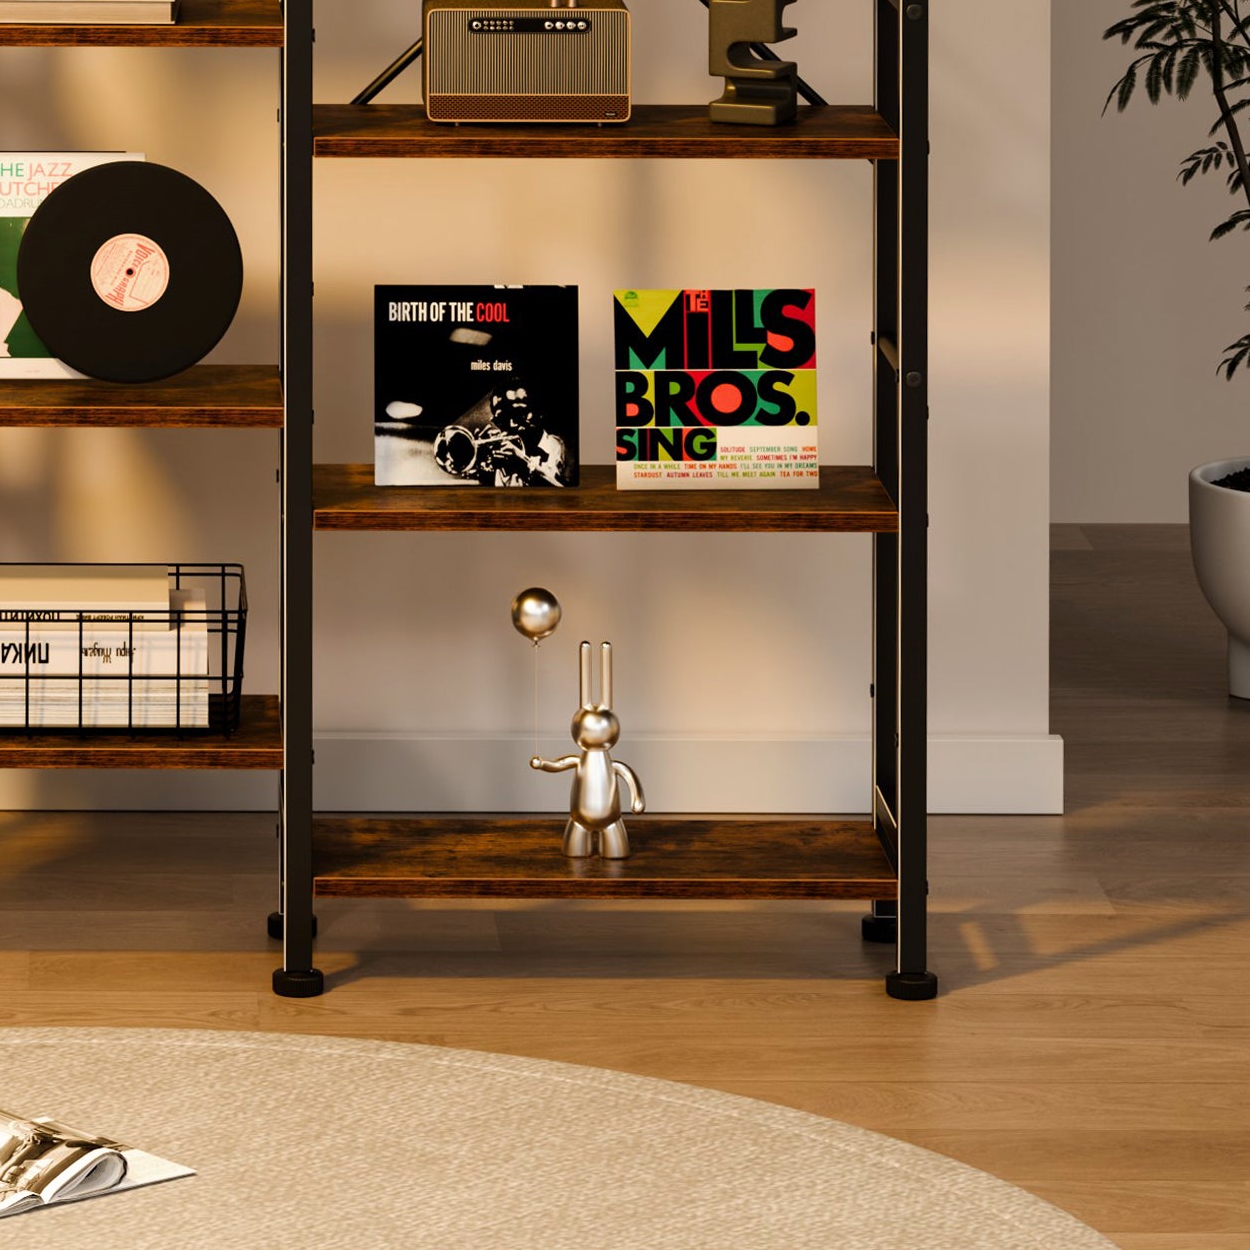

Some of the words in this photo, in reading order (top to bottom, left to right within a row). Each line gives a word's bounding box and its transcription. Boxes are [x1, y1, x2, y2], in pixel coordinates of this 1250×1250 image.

[28, 162, 72, 180] JAZZ
[388, 302, 428, 322] BIRTH
[430, 302, 447, 322] OF
[448, 302, 474, 322] THE
[476, 302, 510, 322] COOL
[613, 289, 816, 370] MILLS
[470, 360, 491, 370] miles
[493, 360, 513, 371] davis
[615, 370, 811, 427] BROS.
[616, 427, 718, 462] SING
[720, 446, 746, 454] SOLITUDE
[750, 446, 781, 454] SEPTEMBER
[784, 446, 798, 454] SONG
